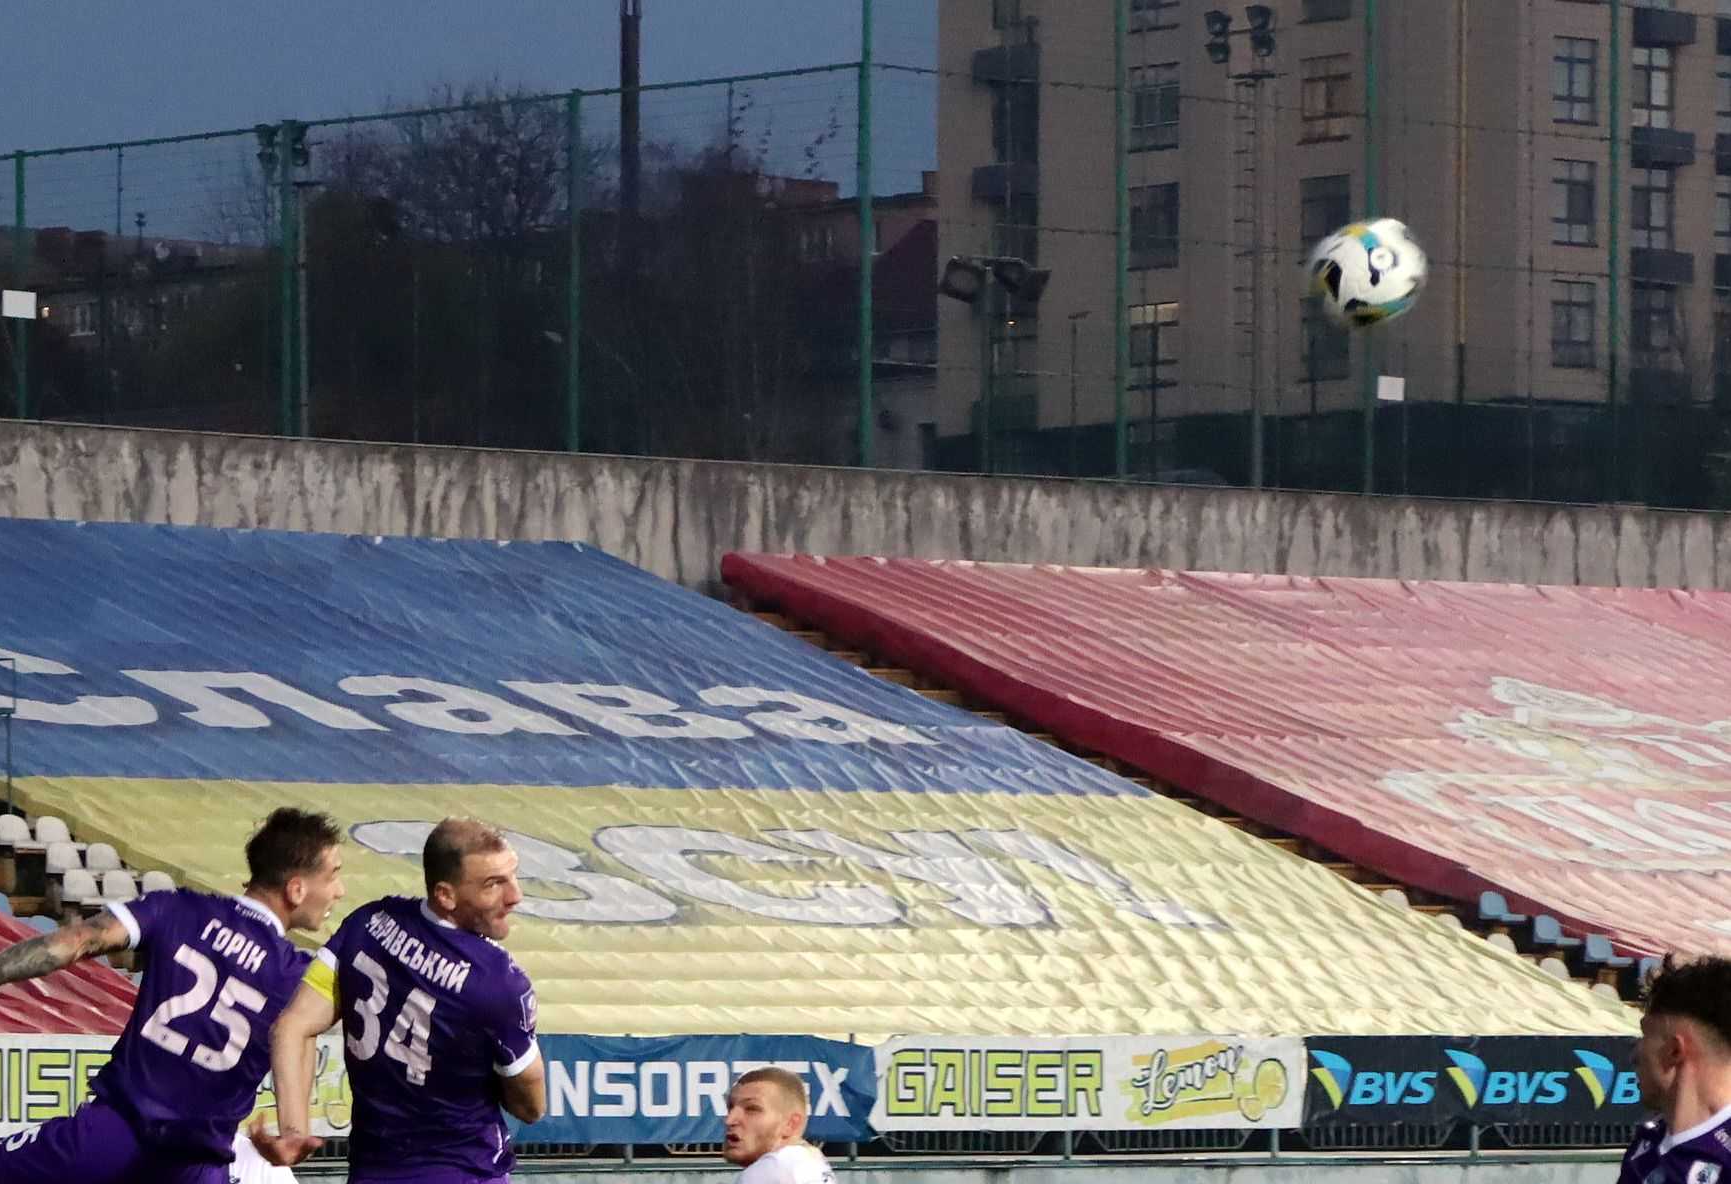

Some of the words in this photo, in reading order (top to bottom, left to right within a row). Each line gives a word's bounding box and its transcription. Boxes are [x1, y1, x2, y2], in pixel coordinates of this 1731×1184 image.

[140, 944, 268, 1072] 25
[345, 949, 438, 1086] 34
[885, 1049, 1104, 1117] GAISER
[1131, 1045, 1244, 1116] Lemon
[1349, 1071, 1437, 1105] BVS
[1483, 1071, 1570, 1104] BVS
